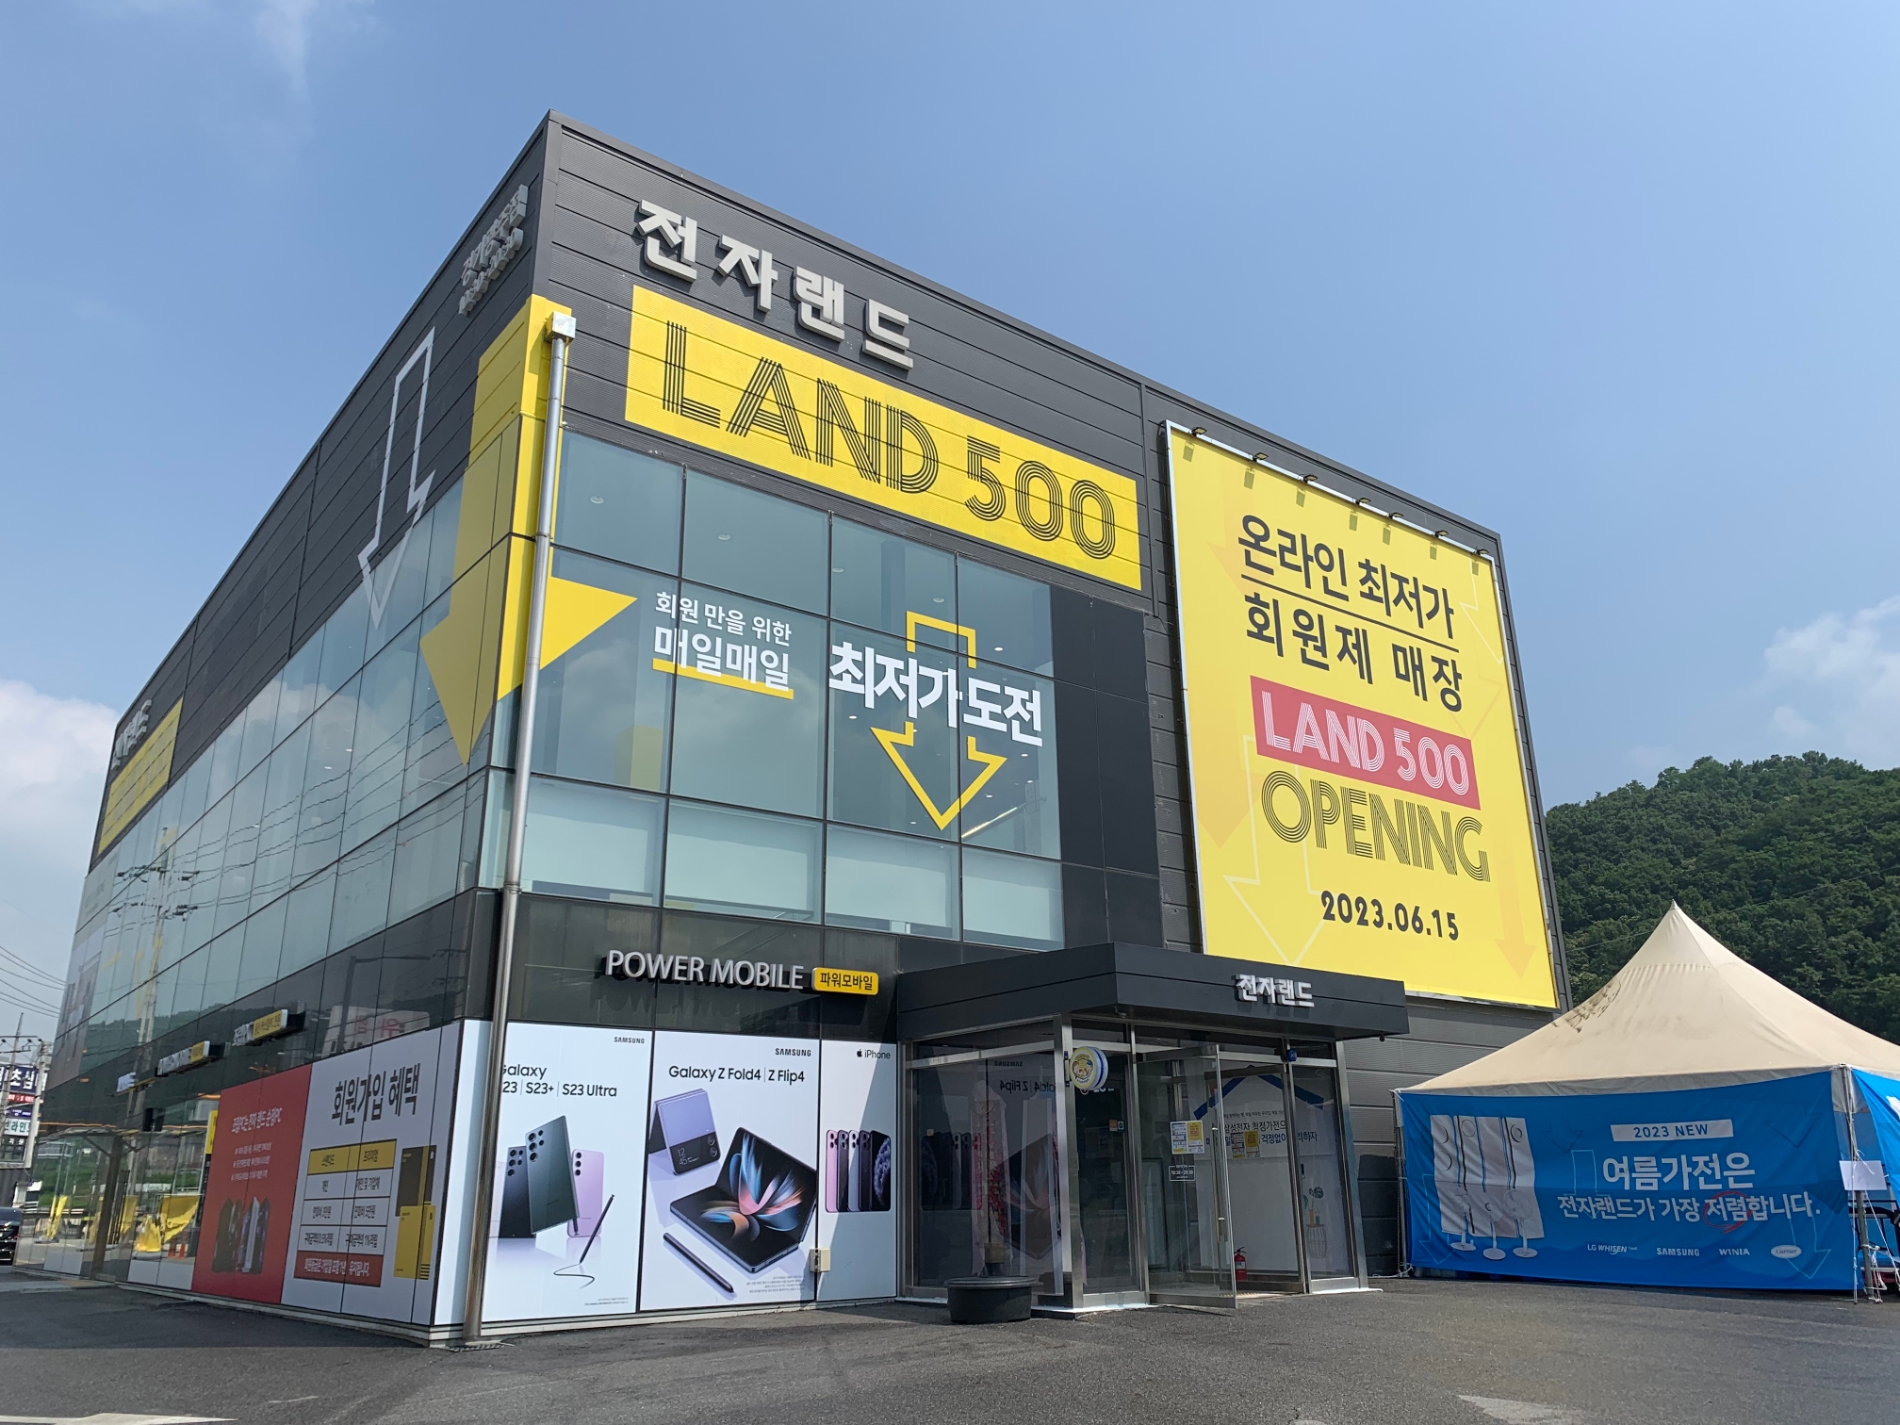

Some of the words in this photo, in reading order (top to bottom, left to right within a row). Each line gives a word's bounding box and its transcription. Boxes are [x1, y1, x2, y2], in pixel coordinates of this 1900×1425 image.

[636, 200, 913, 370] 전자랜드
[662, 321, 939, 495] LAND
[964, 434, 1116, 560] 500
[1238, 514, 1349, 601] 온라인
[1359, 558, 1454, 639] 최저가
[655, 592, 699, 625] 회원
[704, 602, 746, 635] 만을
[752, 616, 792, 647] 위한
[654, 625, 790, 692] 매일매일
[1245, 592, 1374, 684] 회원제
[1394, 644, 1463, 712] 매장
[829, 641, 1043, 746] 최저가도전
[1262, 691, 1384, 773] LAND
[1394, 727, 1471, 796] 500
[1261, 770, 1491, 882] OPENING
[1321, 890, 1460, 941] 2023.06.15
[605, 949, 704, 984] POWER
[710, 957, 804, 990] MOBILE
[819, 971, 874, 991] 파워모바일
[1235, 974, 1315, 1007] 전자랜드
[614, 1036, 645, 1044] SAMSUNG
[775, 1048, 812, 1057] SAMSUNG
[864, 1049, 891, 1060] iPhone
[332, 1070, 387, 1126] 회원가입
[388, 1063, 421, 1117] 혜택
[502, 1081, 518, 1093] 23
[525, 1082, 554, 1095] S23+
[562, 1083, 584, 1096] S23
[587, 1084, 617, 1097] Ultra
[669, 1065, 716, 1082] Galaxy
[718, 1067, 726, 1079] Z
[728, 1066, 761, 1081] Fold4
[768, 1070, 775, 1081] Z
[778, 1069, 805, 1086] Flip4
[1633, 1124, 1670, 1138] 2023
[1675, 1123, 1708, 1138] NEW
[1603, 1152, 1755, 1191] 여름가전은
[1558, 1195, 1655, 1221] 전자랜드가
[1662, 1197, 1700, 1223] 가장
[1706, 1191, 1820, 1223] 저렴합니다.
[1587, 1243, 1597, 1251] LG
[1597, 1245, 1627, 1253] WHISEN
[1656, 1247, 1700, 1256] SAMSUNG
[1719, 1248, 1750, 1256] WINIA
